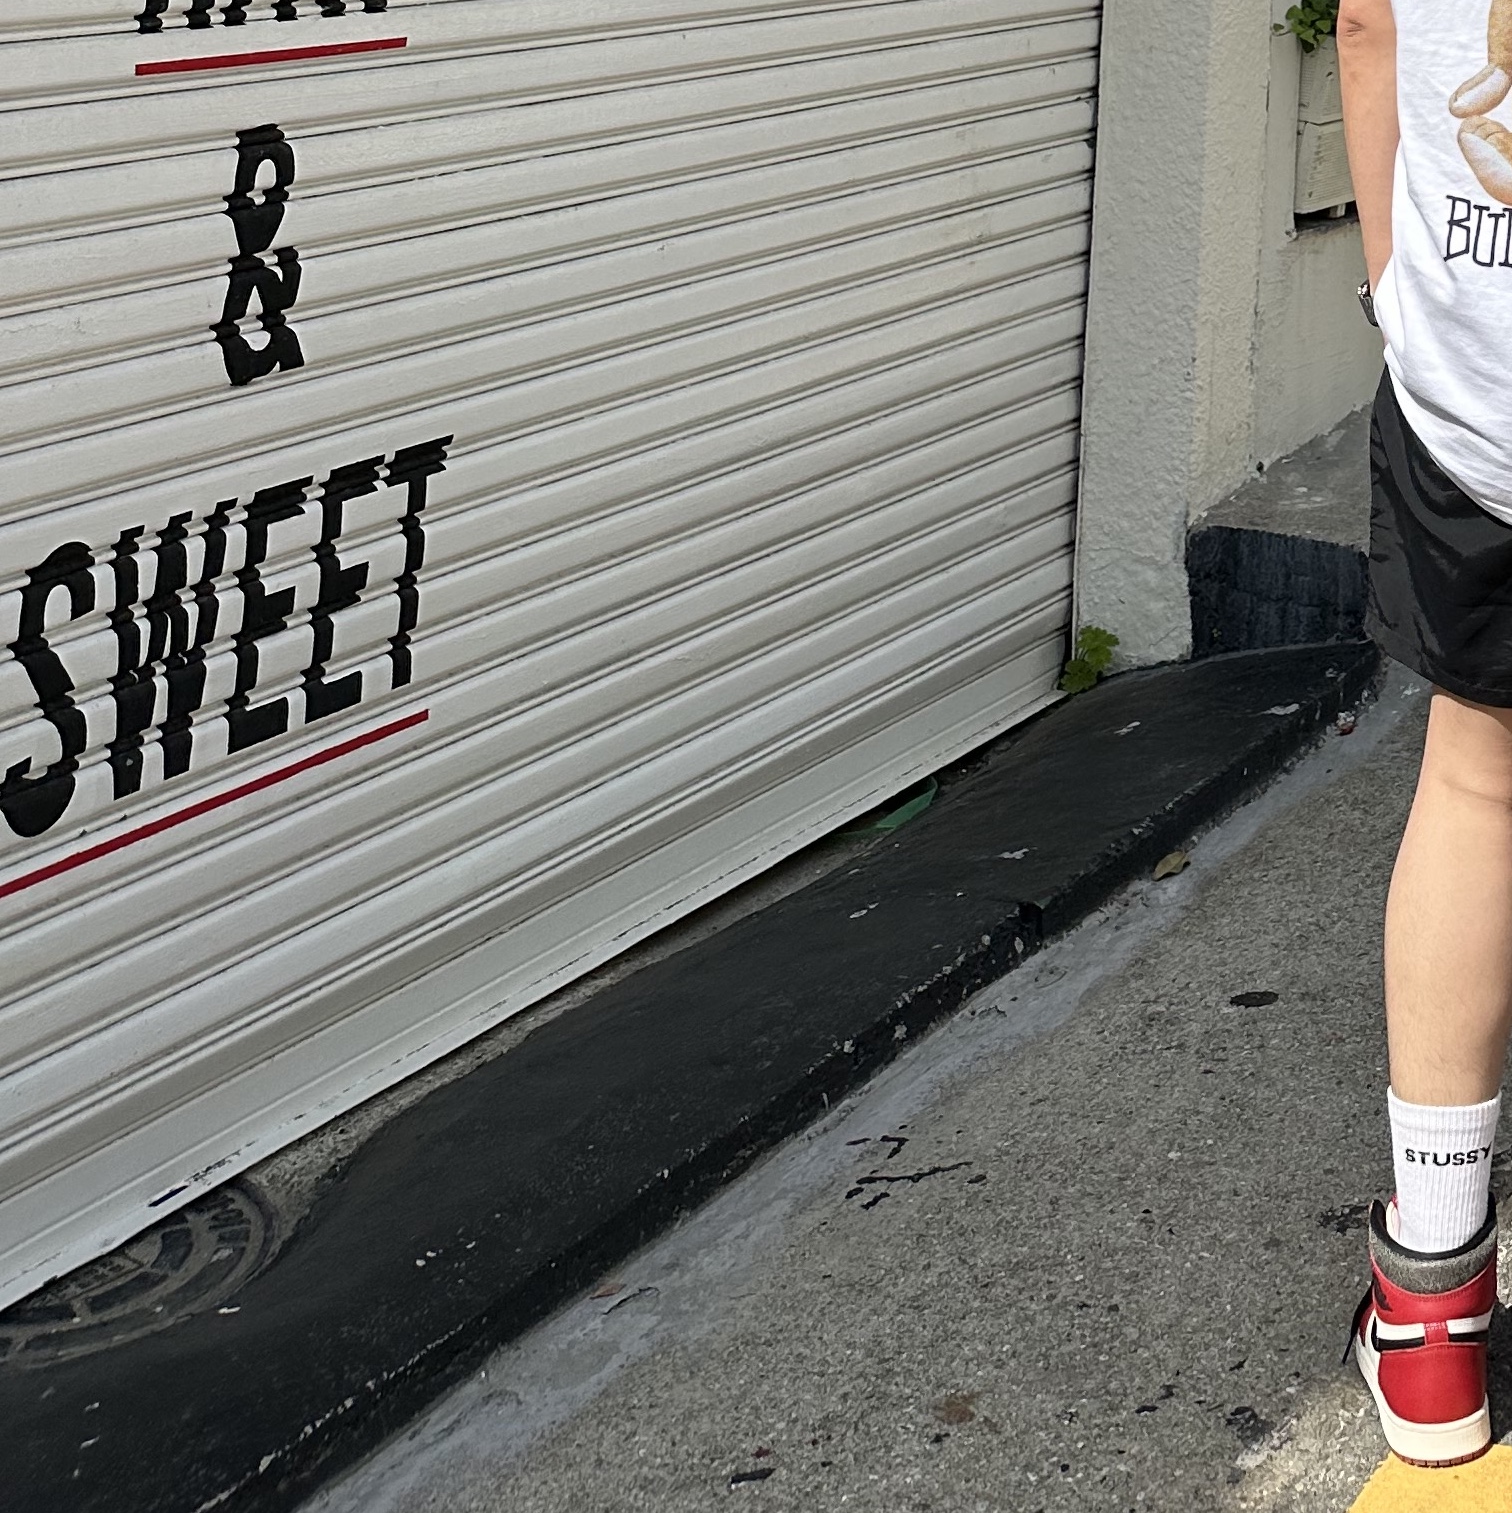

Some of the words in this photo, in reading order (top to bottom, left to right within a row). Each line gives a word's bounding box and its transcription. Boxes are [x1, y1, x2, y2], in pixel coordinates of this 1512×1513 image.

[210, 123, 305, 386] &
[0, 433, 454, 838] SWEET
[1405, 1141, 1492, 1167] STUSSY
